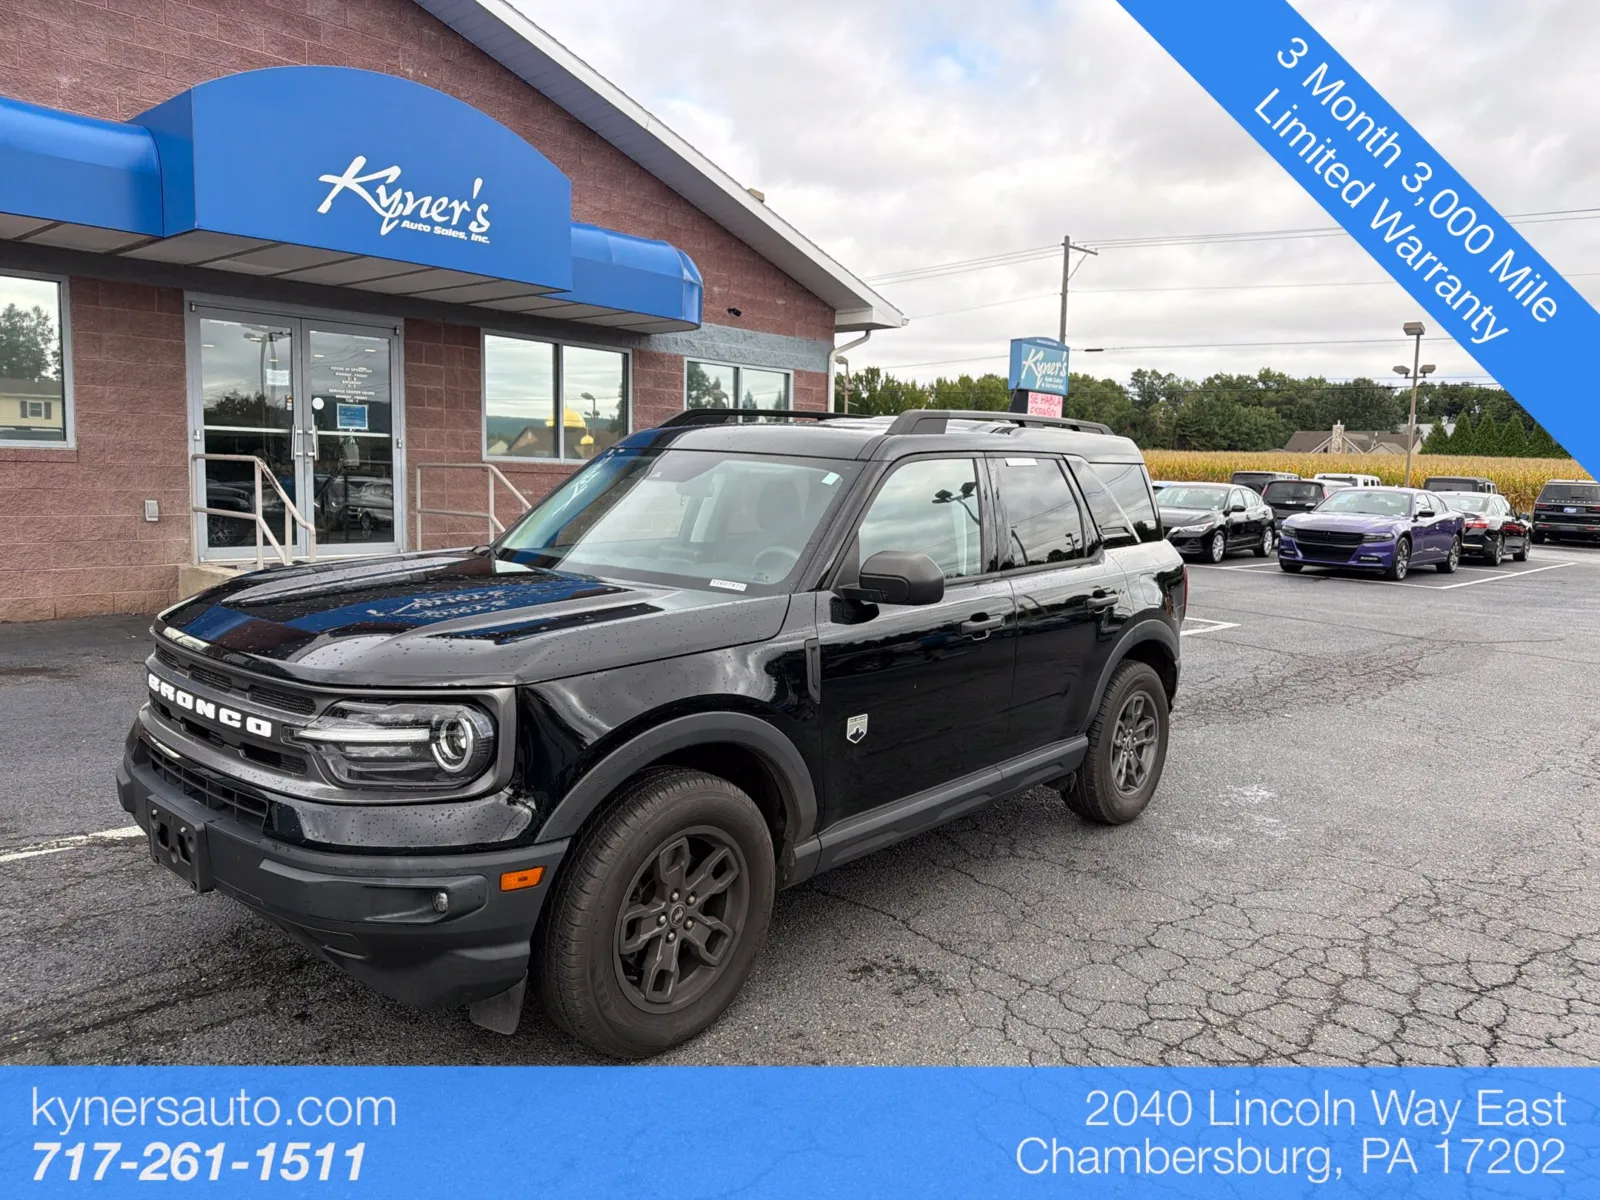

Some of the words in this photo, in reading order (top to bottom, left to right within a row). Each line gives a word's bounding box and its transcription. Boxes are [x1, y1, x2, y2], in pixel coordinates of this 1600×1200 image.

[317, 155, 491, 236] Kyner's
[400, 219, 432, 233] Auto
[433, 225, 468, 241] Sales,
[470, 232, 490, 244] Inc.
[1021, 348, 1067, 389] Kyner's
[148, 673, 272, 738] BRONCO
